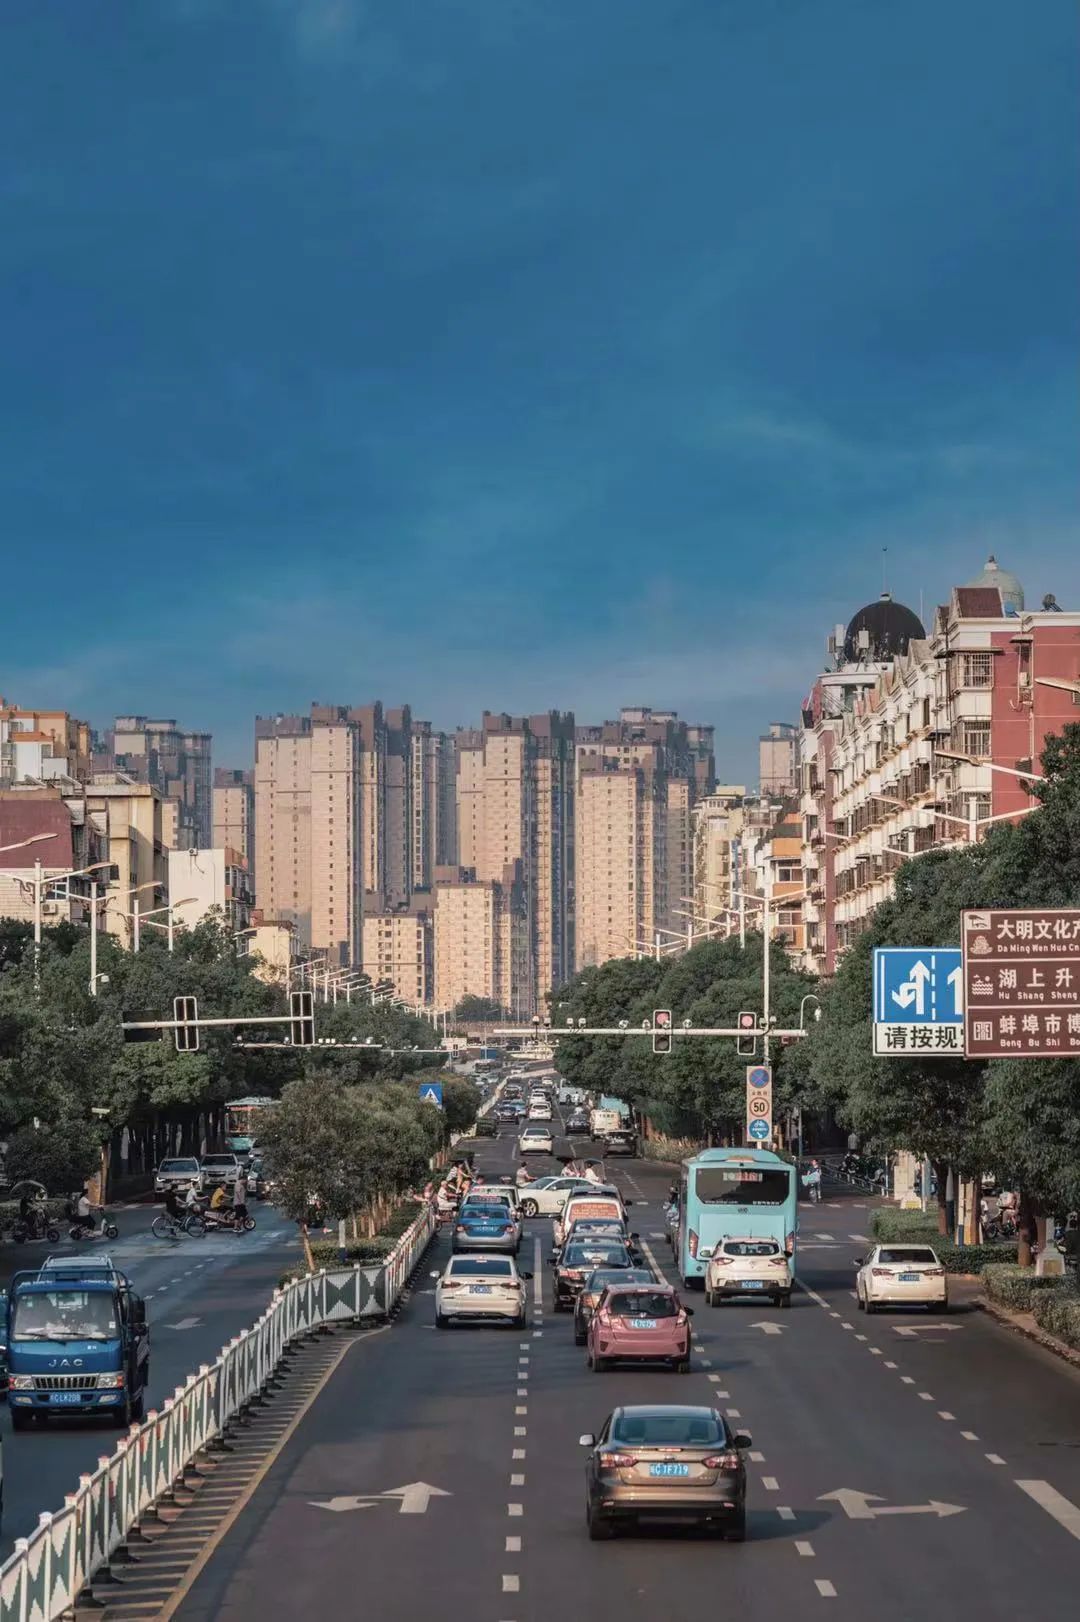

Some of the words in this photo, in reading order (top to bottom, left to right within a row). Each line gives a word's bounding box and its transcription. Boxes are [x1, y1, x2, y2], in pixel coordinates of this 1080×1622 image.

[997, 944, 1008, 952] Da
[1010, 944, 1031, 954] Ming
[1032, 943, 1049, 952] Wen
[1050, 943, 1067, 952] Hua
[998, 967, 1074, 989] 湖上升
[998, 991, 1010, 1000] Hu
[1017, 991, 1045, 1003] Shang
[1051, 991, 1078, 1001] Sheng
[999, 1013, 1080, 1035] 蚌埠市博
[884, 1025, 964, 1049] 请按规
[1000, 1038, 1022, 1048] Beng
[1028, 1037, 1040, 1047] Bu
[1046, 1037, 1060, 1046] Shi
[753, 1102, 765, 1113] 50
[48, 1358, 83, 1367] JAC
